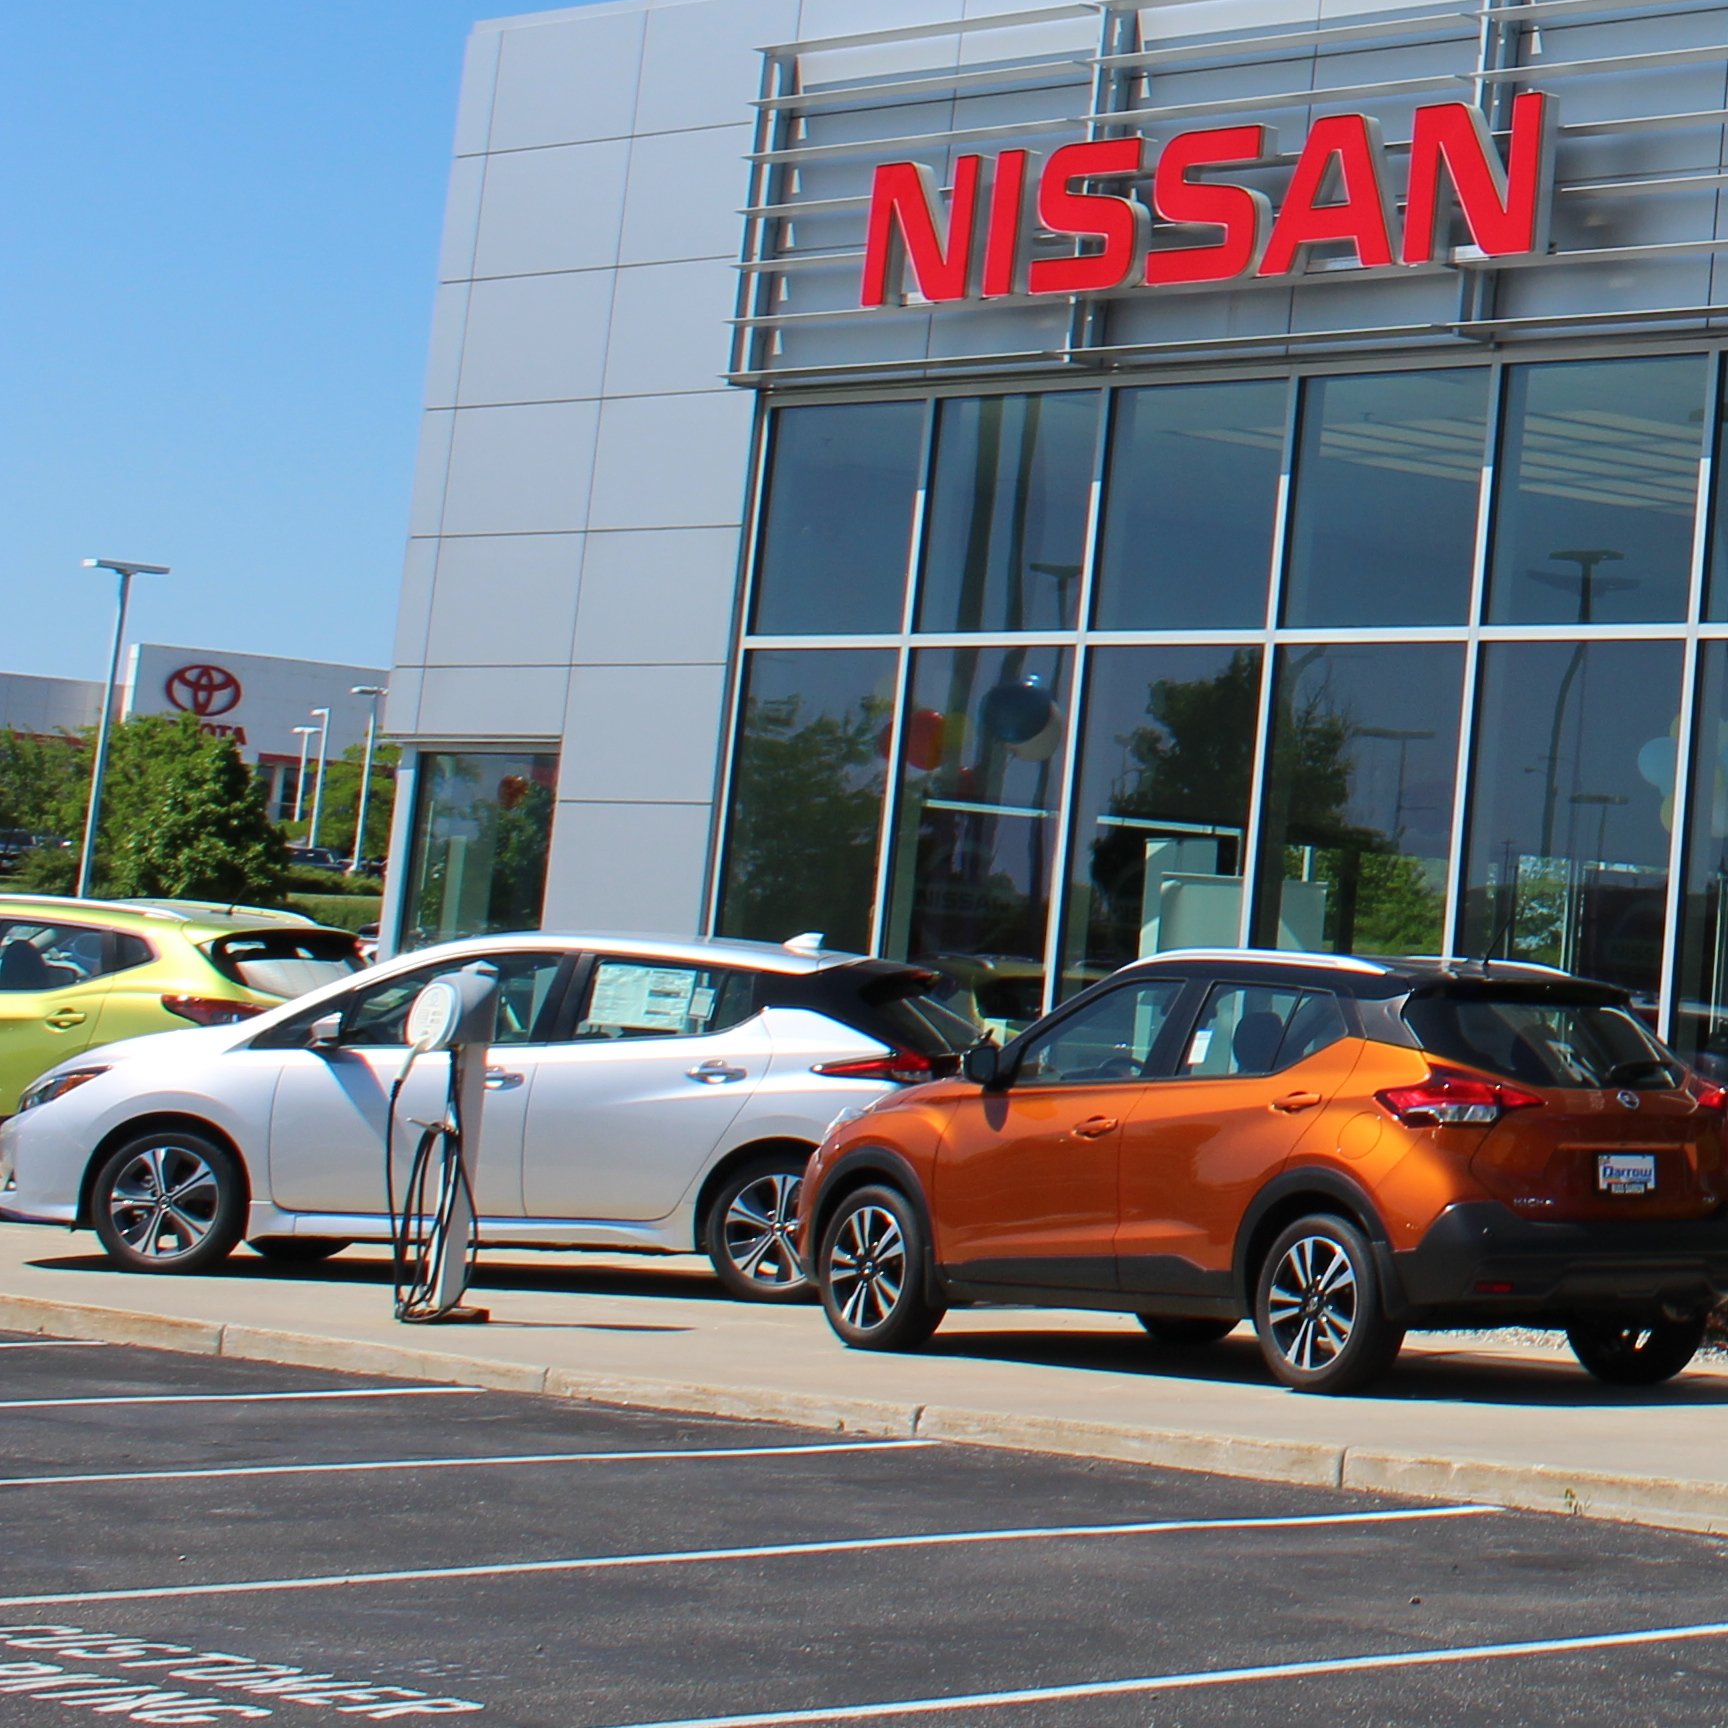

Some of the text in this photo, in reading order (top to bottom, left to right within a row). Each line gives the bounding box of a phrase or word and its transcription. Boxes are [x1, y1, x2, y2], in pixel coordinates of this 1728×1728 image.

[859, 88, 1560, 308] NISSAN
[1603, 1166, 1652, 1178] Darrow
[0, 1625, 485, 1720] CUSTOMER
[0, 1661, 272, 1725] RKING
